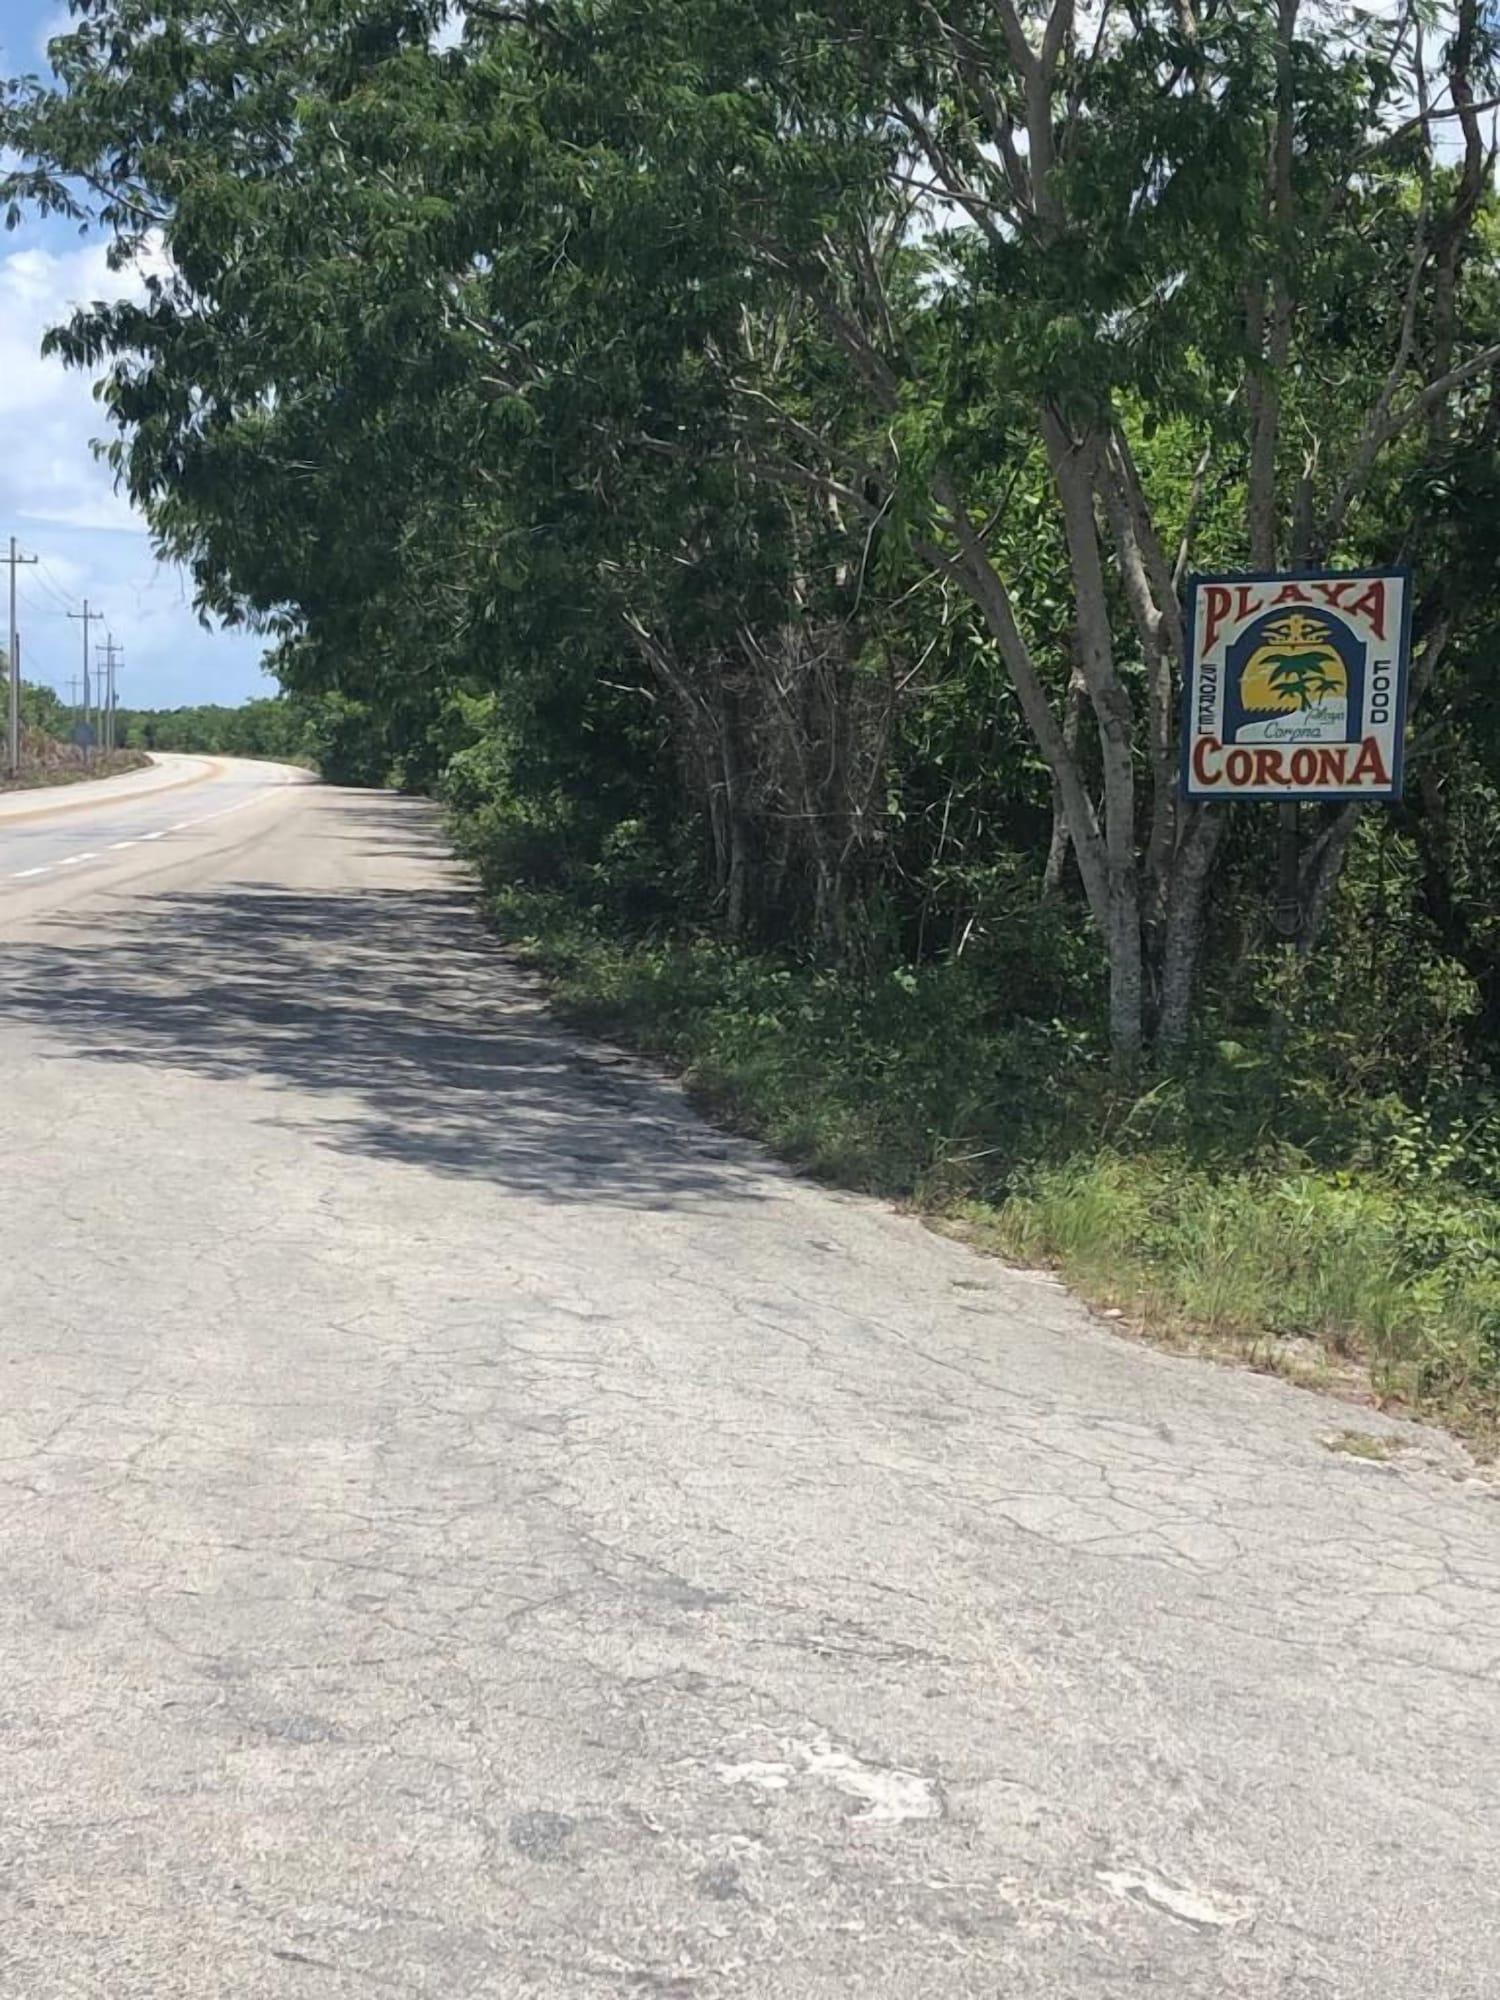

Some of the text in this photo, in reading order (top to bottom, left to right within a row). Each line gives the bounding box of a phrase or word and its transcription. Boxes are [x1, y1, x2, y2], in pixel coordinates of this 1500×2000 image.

[1202, 580, 1386, 657] PLAYA
[1198, 663, 1217, 735] SNORKEL
[1371, 659, 1391, 724] FOOD
[1193, 736, 1392, 786] CORONA
